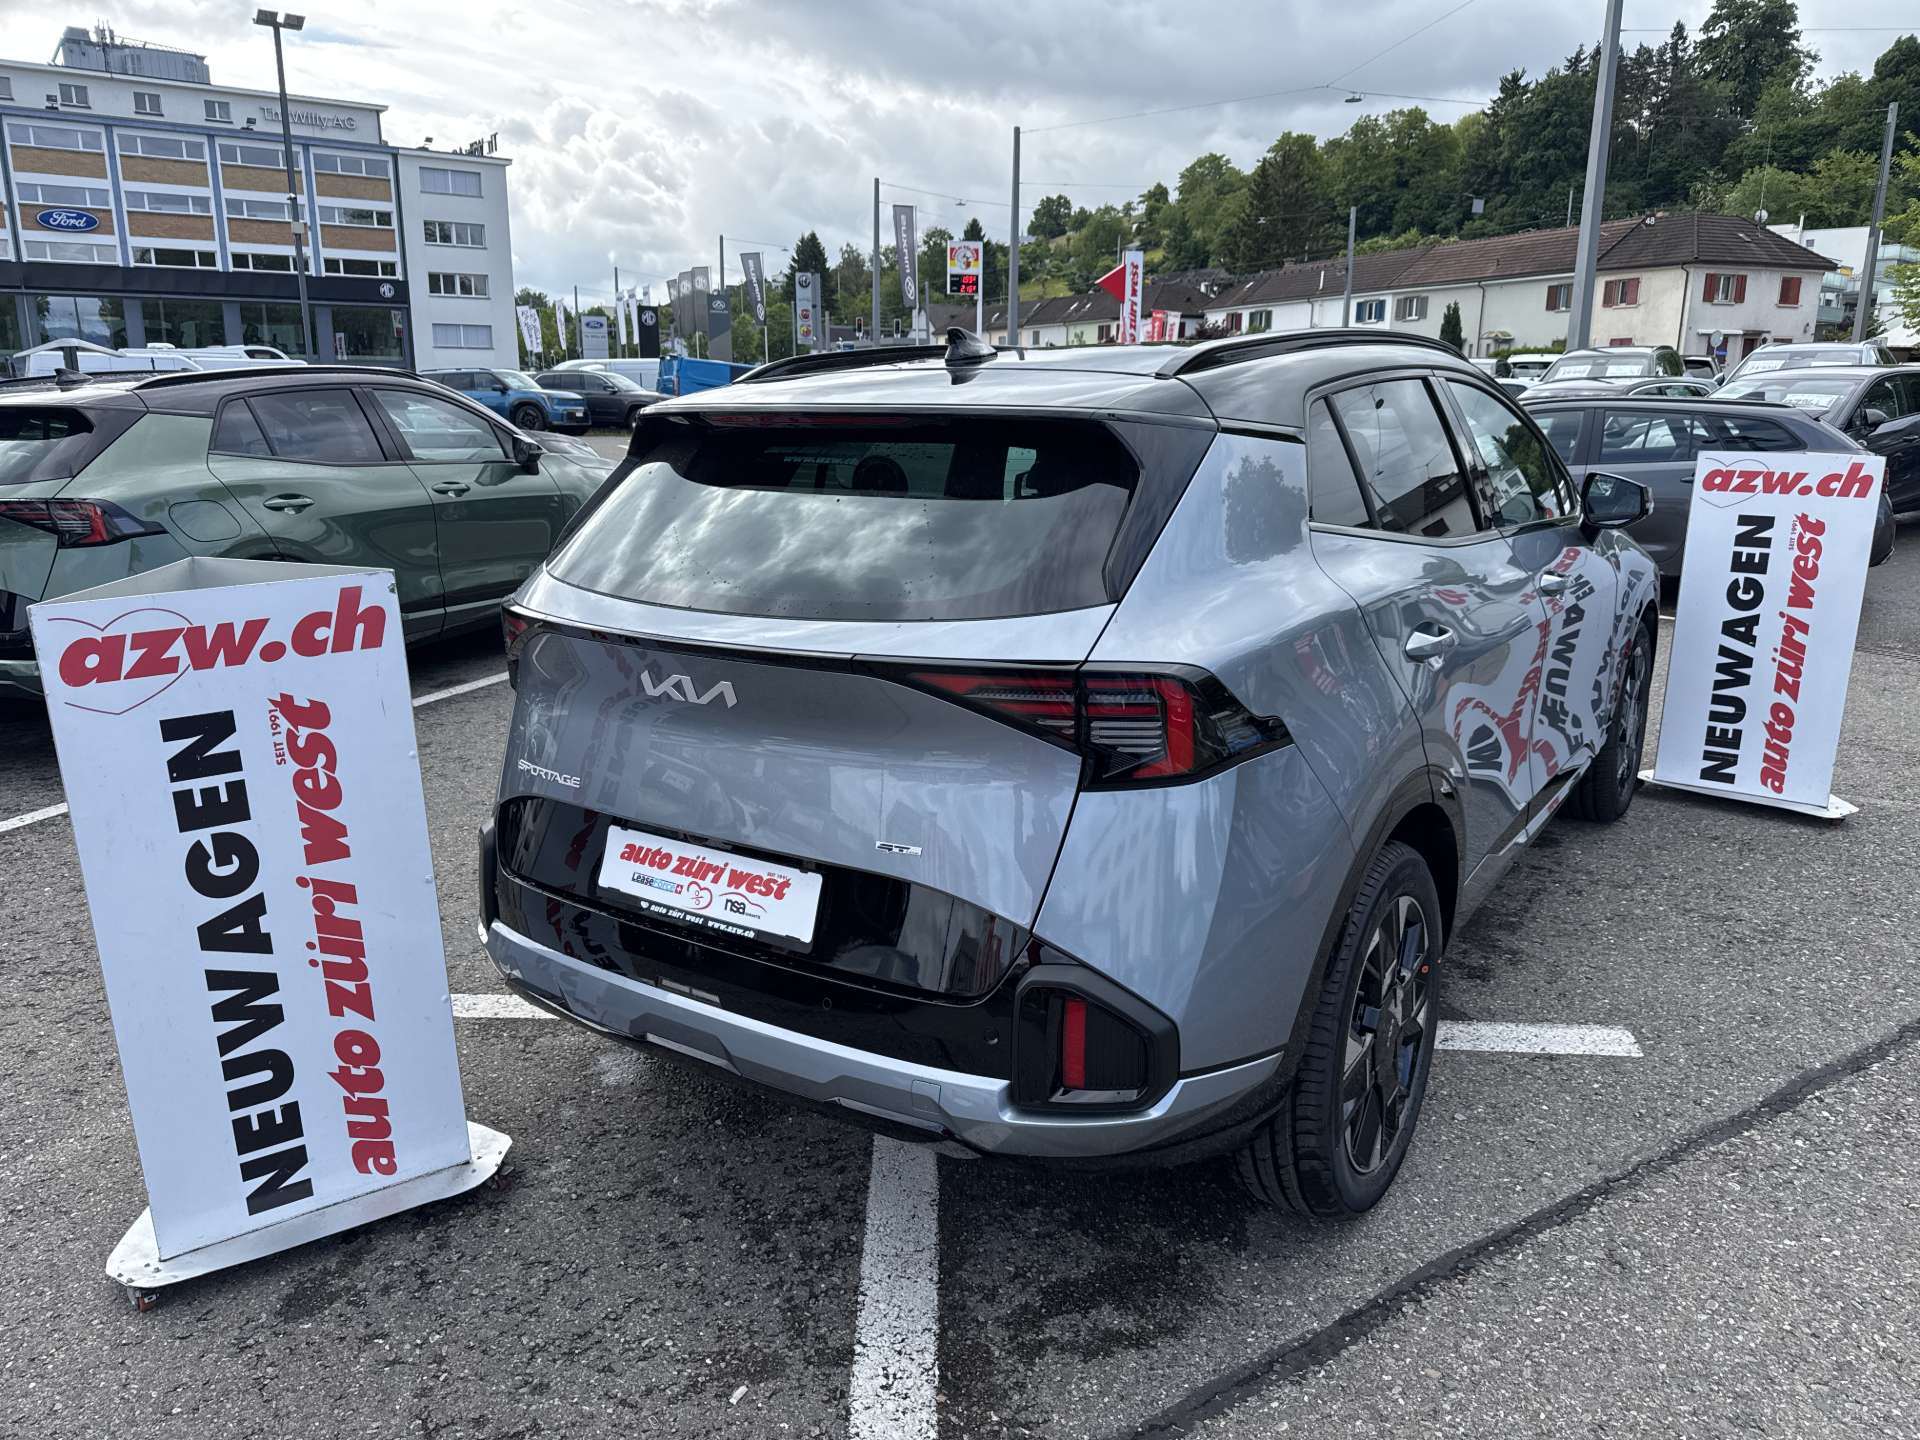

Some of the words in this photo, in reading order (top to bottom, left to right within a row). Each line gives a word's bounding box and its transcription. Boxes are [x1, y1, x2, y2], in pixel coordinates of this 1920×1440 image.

[291, 110, 328, 129] Willy
[333, 114, 357, 130] AG
[49, 211, 87, 227] Ford
[641, 310, 657, 326] MG
[1702, 463, 1875, 498] azw.ch
[1787, 512, 1827, 610] west
[59, 586, 386, 687] azw.ch
[1699, 514, 1776, 785] NEUWAGEN
[1771, 611, 1809, 704] züri
[638, 669, 739, 708] KIA
[268, 708, 282, 737] 1991
[273, 741, 287, 766] SEIT
[1760, 702, 1796, 794] auto
[266, 692, 351, 866] west
[517, 759, 581, 788] SPORTAGE
[620, 843, 673, 870] auto
[670, 855, 729, 885] züri
[726, 868, 792, 901] west
[649, 904, 667, 914] auto
[686, 914, 704, 925] west
[724, 897, 747, 915] nsa
[159, 709, 314, 1216] NEUWAGEN
[295, 876, 375, 1021] züri
[326, 1030, 397, 1176] auto
